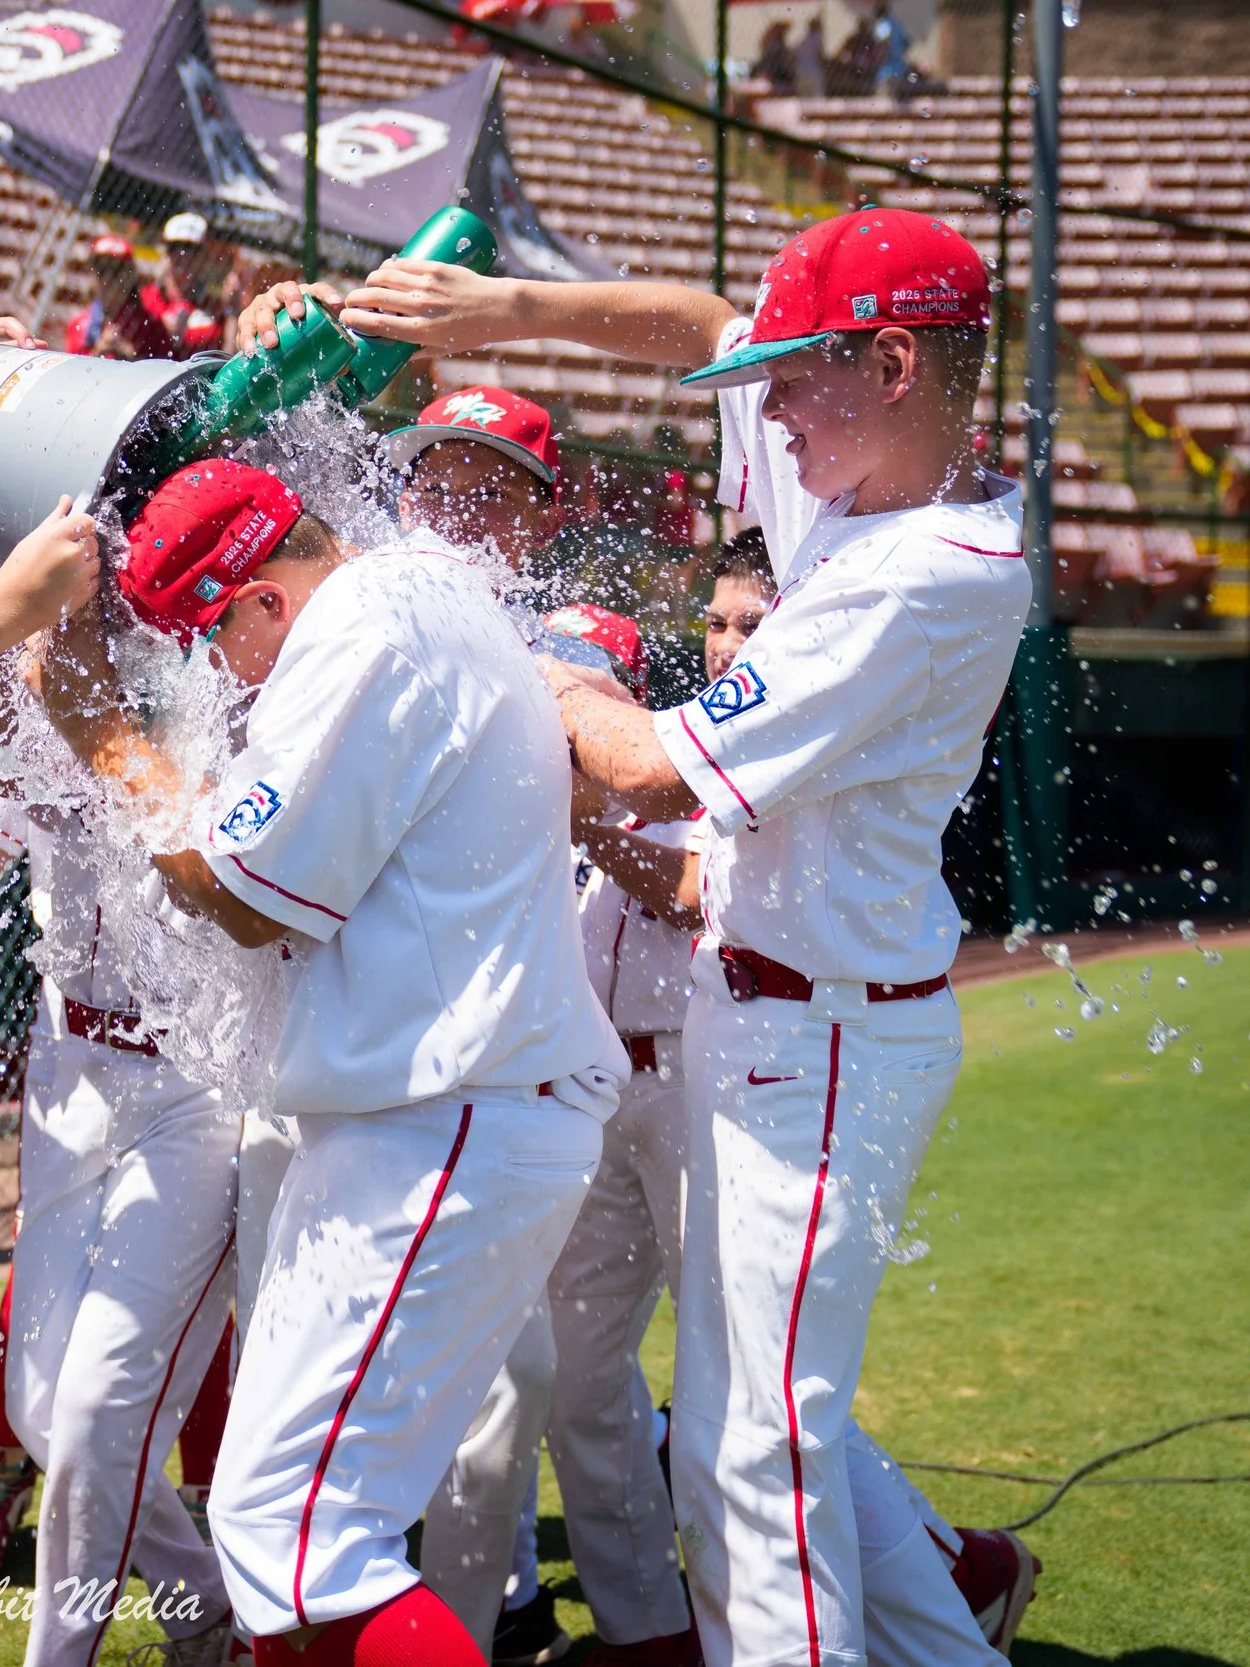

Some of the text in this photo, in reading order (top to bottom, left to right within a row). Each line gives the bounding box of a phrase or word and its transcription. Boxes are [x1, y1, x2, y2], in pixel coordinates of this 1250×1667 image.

[924, 287, 959, 299] STATE
[892, 301, 960, 314] CHAMPIONS
[240, 509, 267, 541] STATE
[231, 518, 277, 573] CHAMPIONS
